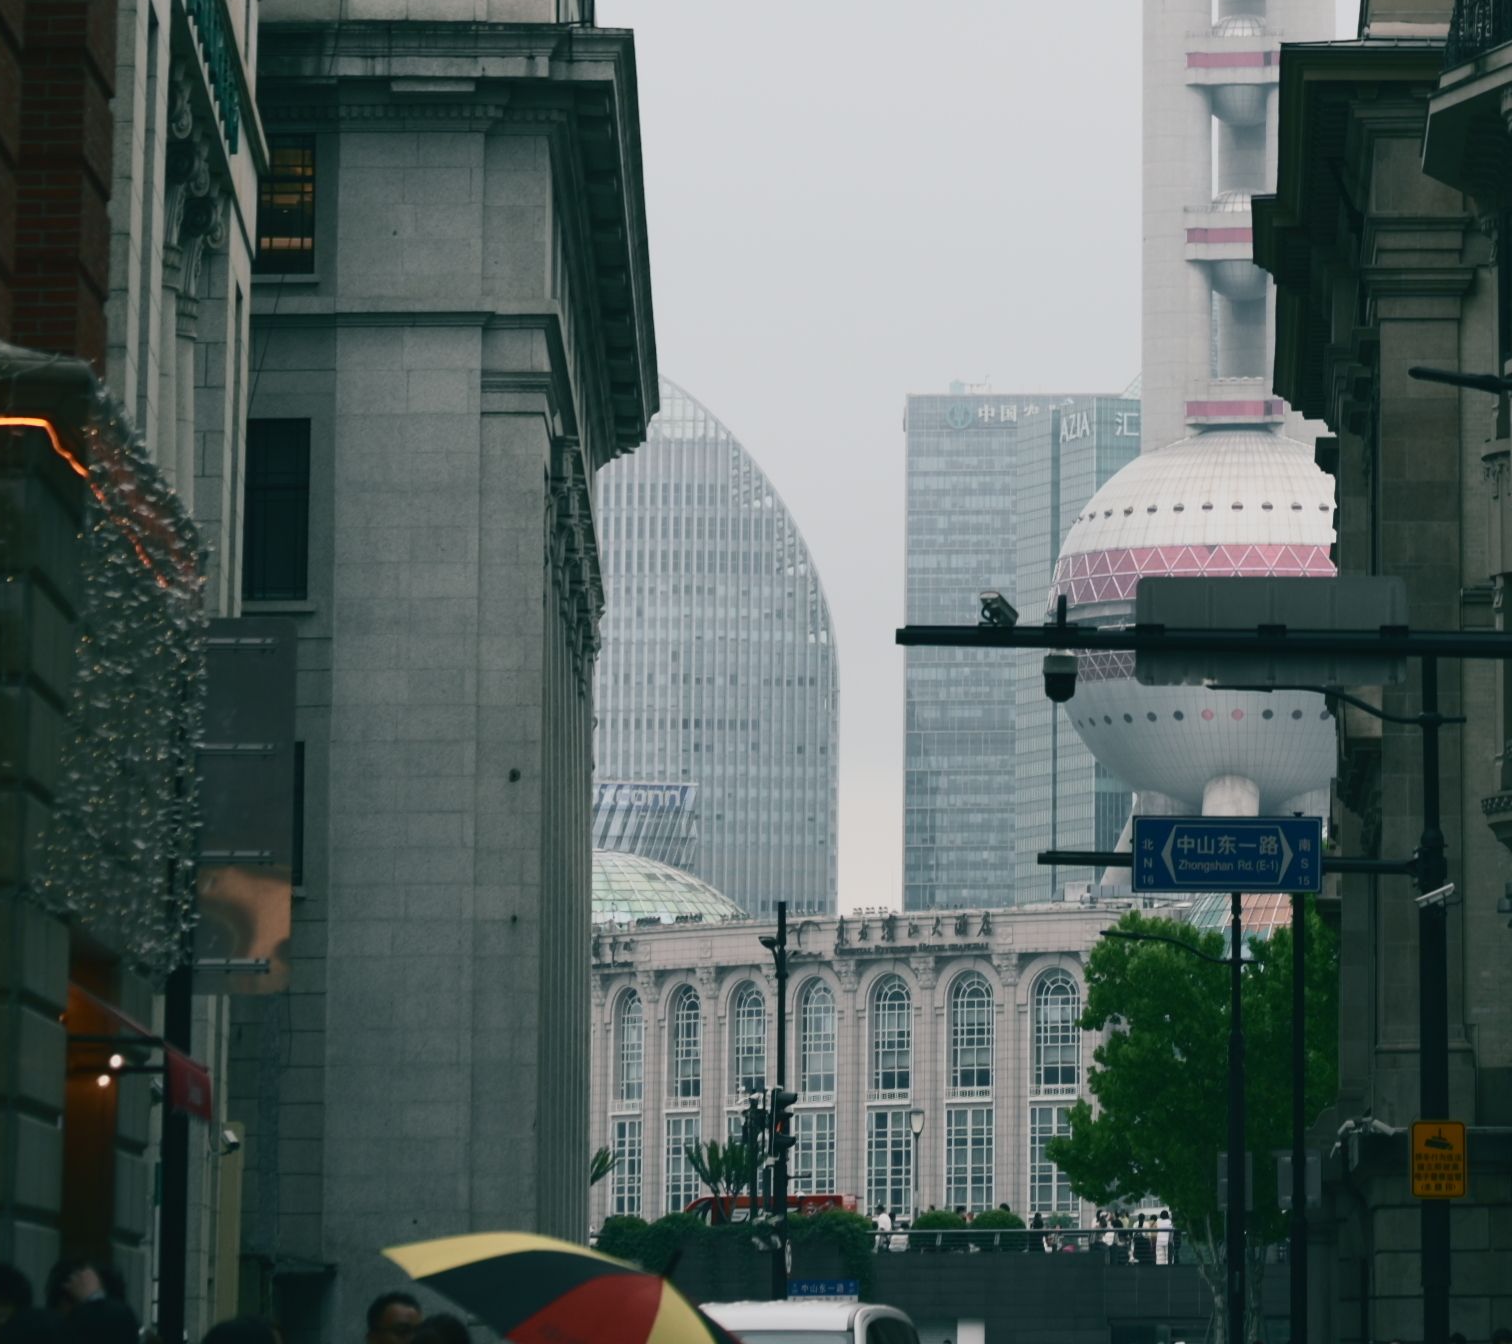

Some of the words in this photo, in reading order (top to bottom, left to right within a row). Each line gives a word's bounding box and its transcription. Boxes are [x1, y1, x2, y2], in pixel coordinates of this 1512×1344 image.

[1060, 411, 1091, 444] AZIA
[1143, 839, 1154, 851] 北
[1176, 835, 1279, 856] 中山东一路
[1299, 838, 1311, 852] 南
[1143, 858, 1153, 869] N
[1178, 859, 1234, 873] Zhongshan
[1300, 858, 1309, 870] S
[1142, 875, 1155, 885] 16
[1297, 875, 1310, 885] 15
